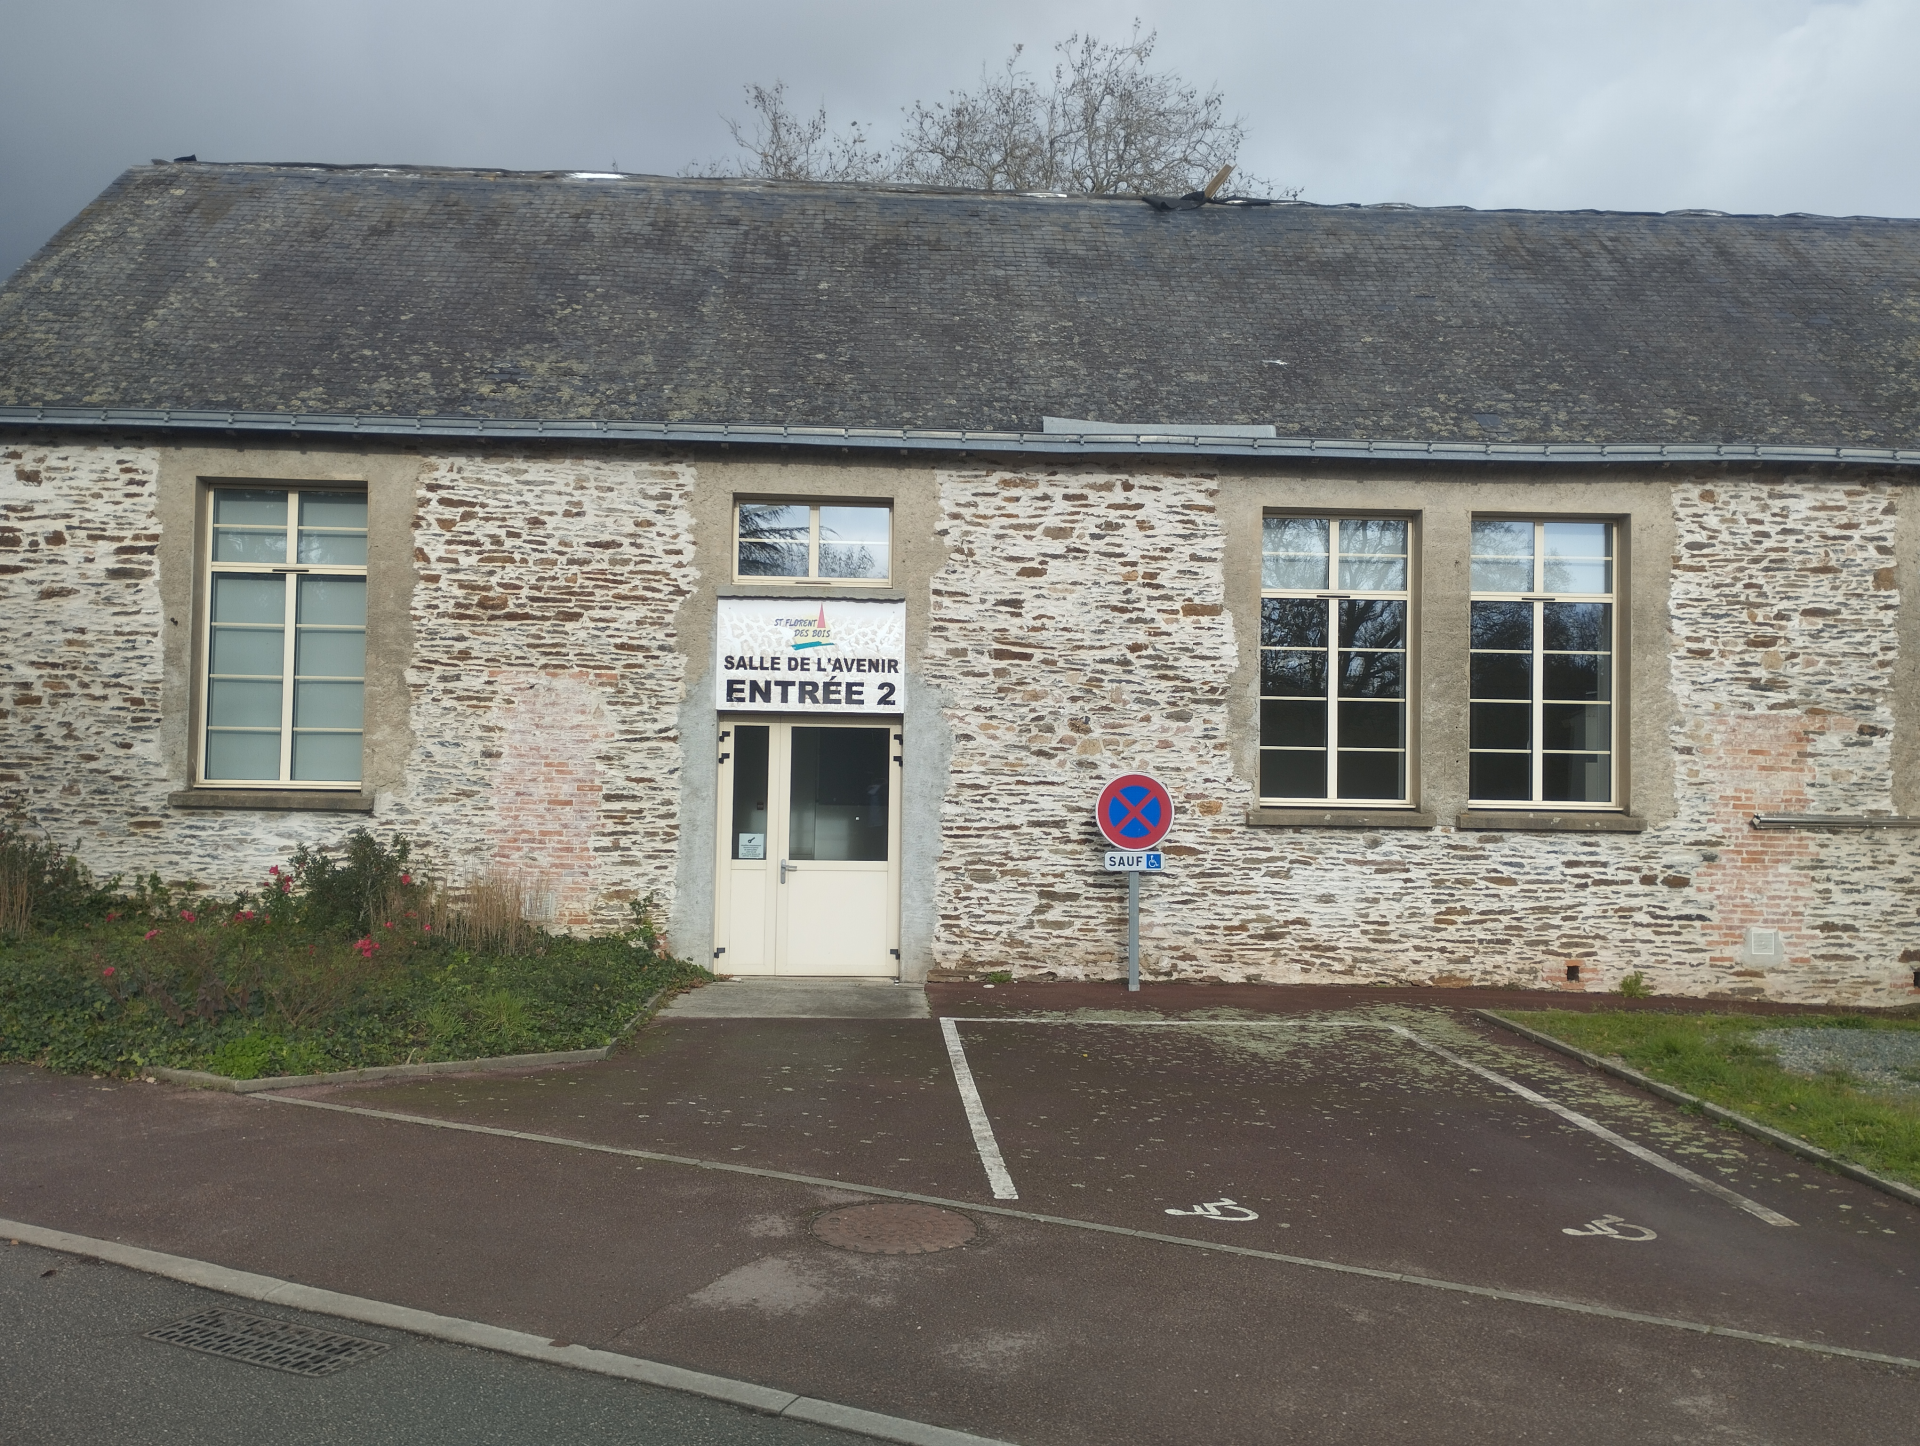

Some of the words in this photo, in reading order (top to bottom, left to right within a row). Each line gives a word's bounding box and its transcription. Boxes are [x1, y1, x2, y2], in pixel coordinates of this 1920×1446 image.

[774, 618, 784, 627] ST
[785, 618, 818, 628] FLORENT
[794, 629, 809, 638] DES
[812, 629, 831, 638] BOIS
[724, 655, 781, 671] SALLE
[787, 656, 811, 672] DE
[816, 658, 899, 674] L'AVENIR
[726, 675, 865, 705] ENTRÉE
[876, 681, 896, 706] 2
[1108, 856, 1143, 867] SAUF
